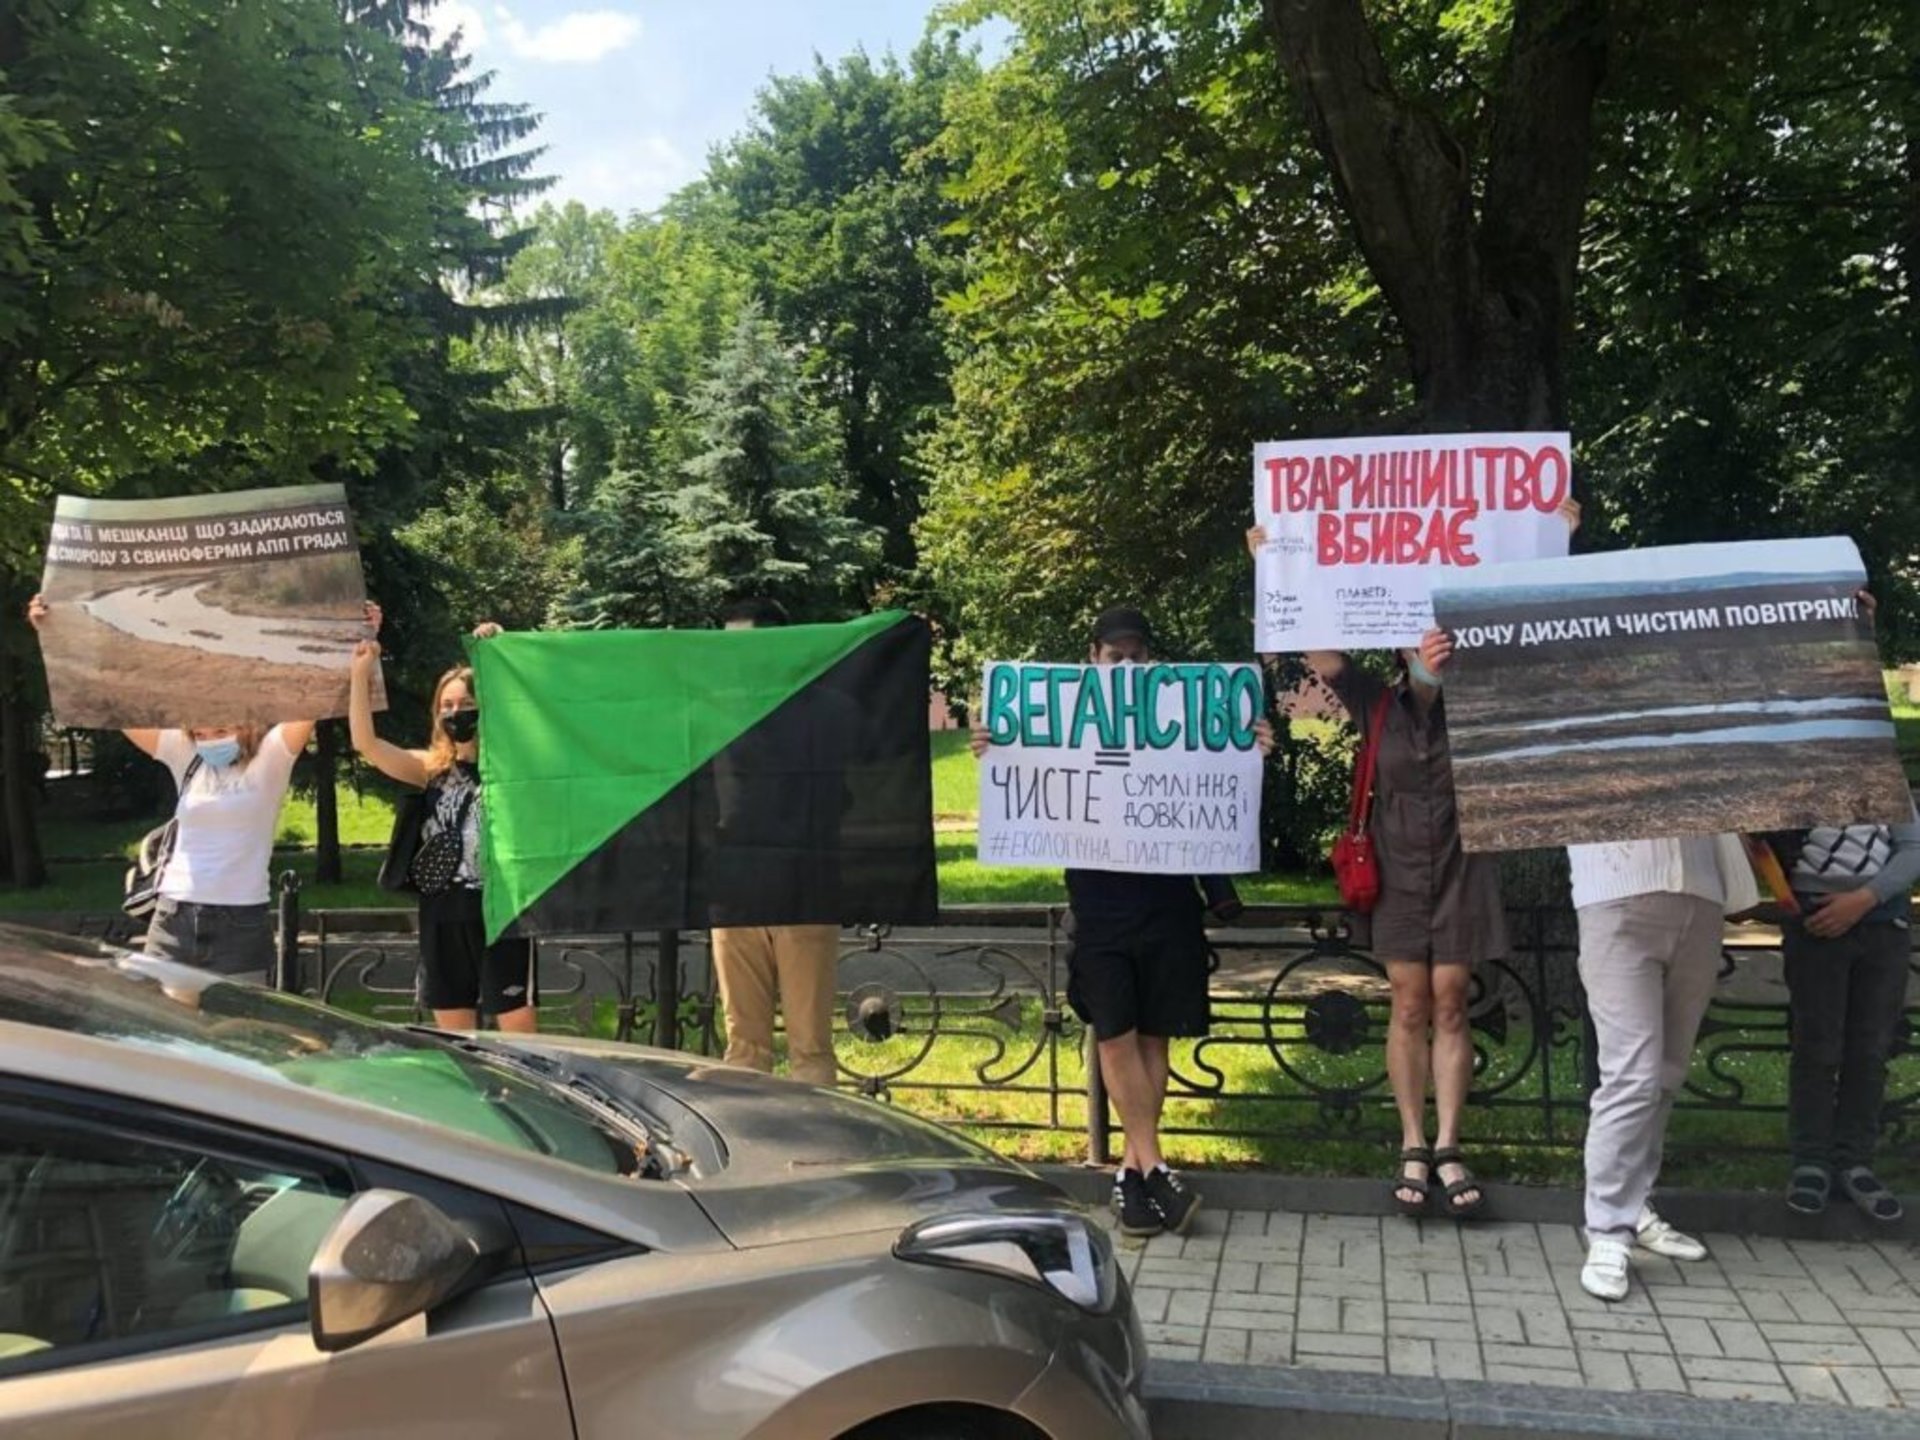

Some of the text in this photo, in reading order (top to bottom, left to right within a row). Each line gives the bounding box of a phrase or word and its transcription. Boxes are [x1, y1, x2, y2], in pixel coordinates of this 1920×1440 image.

[1264, 445, 1568, 514] ТВАРИННИЦТВО
[98, 526, 188, 544] МЕШКАНЦІ
[195, 521, 225, 541] ЩО
[229, 510, 346, 537] ЗАДИХАЮТЬСЯ
[133, 544, 252, 565] СВИНОФЕРМИ
[256, 537, 290, 556] АПП
[292, 531, 349, 551] ГРЯДА!
[1316, 508, 1481, 567] ВБИВАЄ
[1453, 597, 1859, 650] ХОЧУ ДИХАТИ ЧИСТИМ ПОВІТРЯМ!
[988, 664, 1264, 751] ВЕГАНСТВО
[991, 765, 1102, 824] ЧИСТЕ
